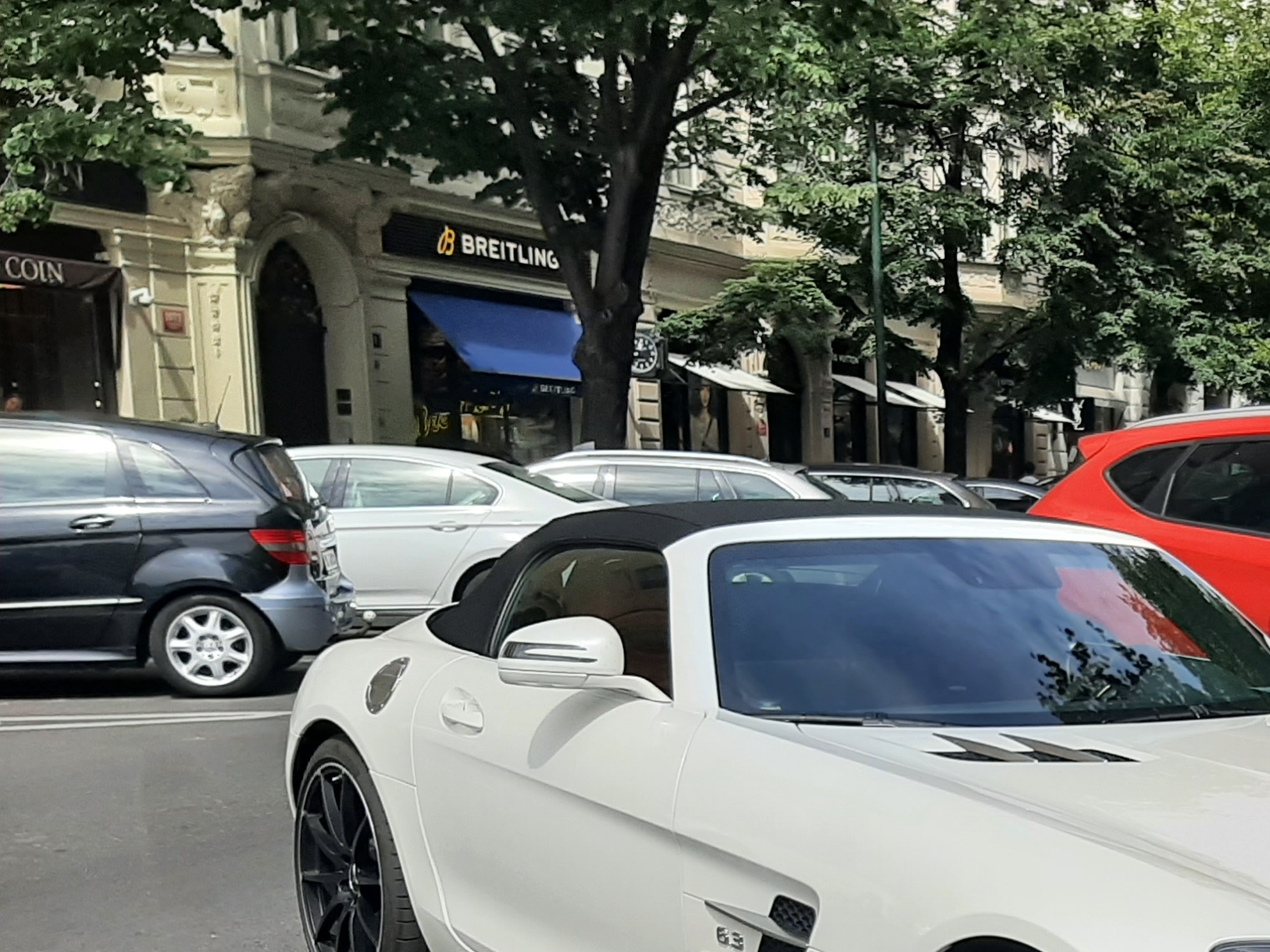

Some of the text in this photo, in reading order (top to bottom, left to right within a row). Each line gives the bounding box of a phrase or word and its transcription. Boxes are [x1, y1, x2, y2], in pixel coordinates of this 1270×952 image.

[461, 233, 560, 270] BREITLING
[5, 256, 65, 284] COIN
[716, 926, 744, 951] 63
